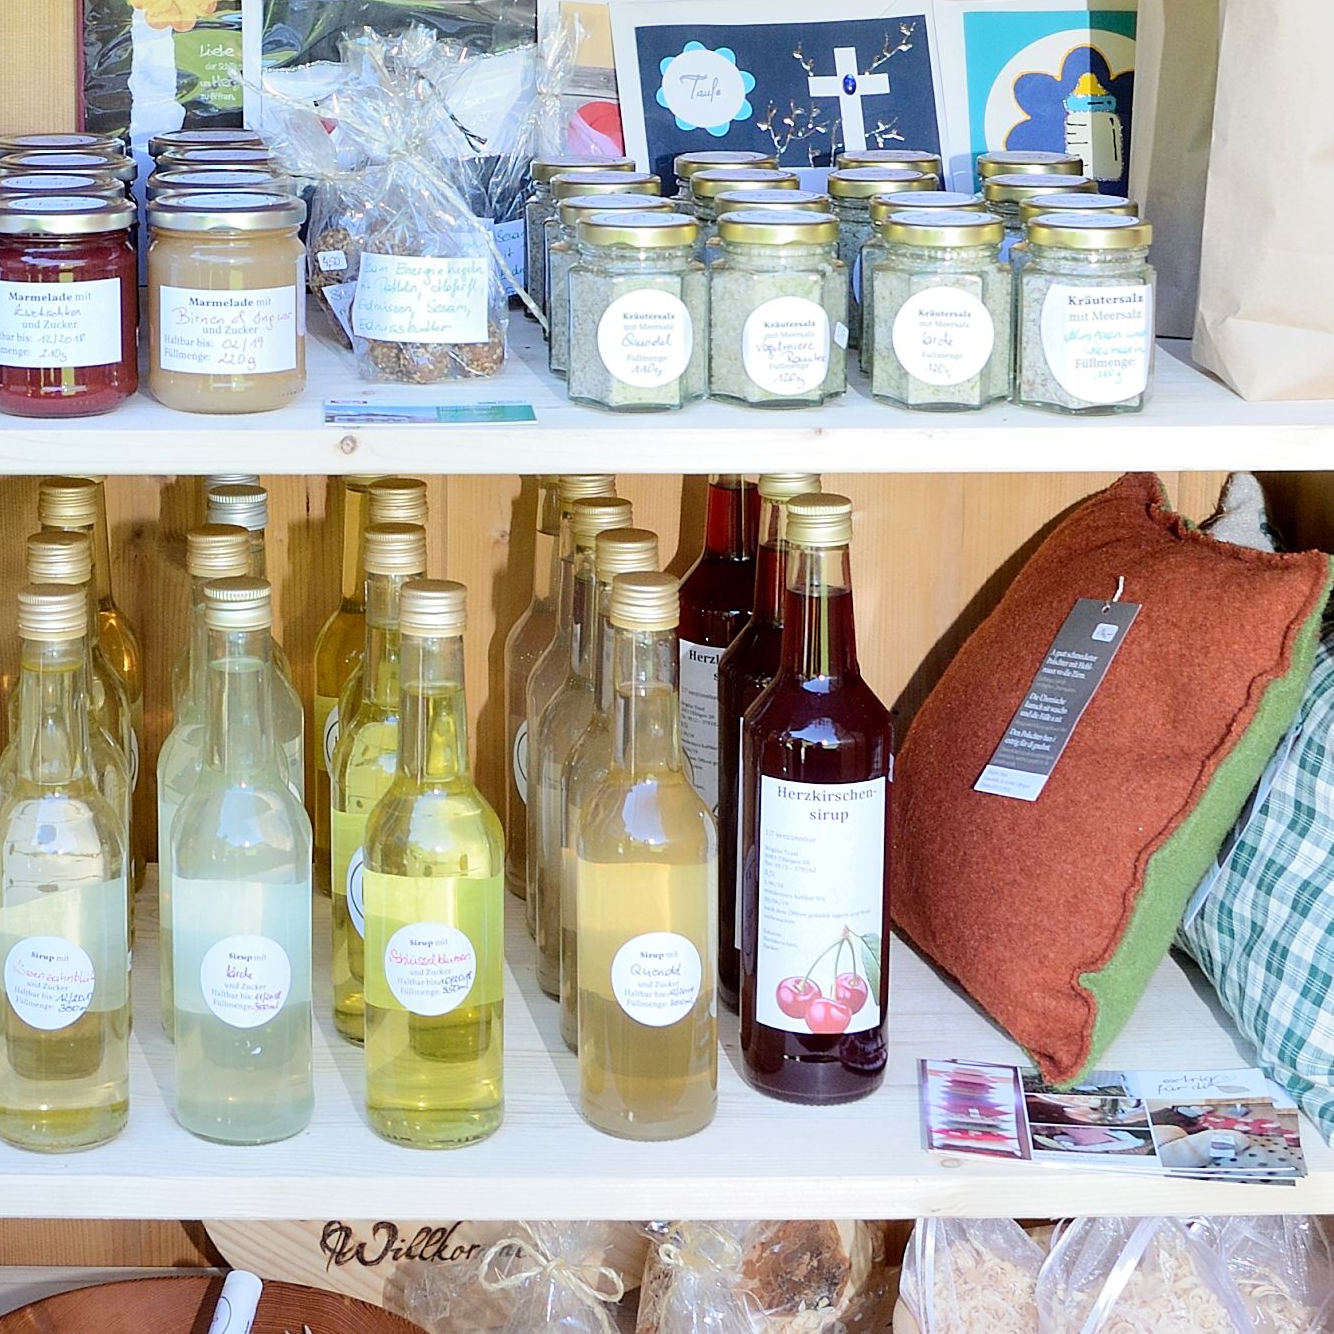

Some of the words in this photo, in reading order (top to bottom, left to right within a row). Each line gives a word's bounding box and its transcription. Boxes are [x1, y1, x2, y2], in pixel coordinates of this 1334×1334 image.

[9, 292, 72, 302] Marmelade
[76, 292, 91, 301] mit
[189, 297, 253, 307] Marmelade
[256, 297, 271, 306] mit
[1068, 293, 1143, 305] Kräutersalz
[623, 312, 675, 320] Kräutersalz
[918, 309, 971, 318] Kräutersalz
[1092, 309, 1142, 321] Meersalz
[22, 320, 40, 329] und
[43, 320, 77, 329] Zucker
[640, 323, 674, 331] Meersalz
[764, 320, 815, 328] Kräutersalz
[203, 325, 221, 334] und
[223, 325, 258, 334] Zucker
[165, 335, 195, 347] Haltbar
[165, 349, 210, 361] Füllmenge:
[777, 785, 877, 802] Herzkirschen-
[809, 808, 849, 823] sirup
[410, 938, 434, 948] Sirup
[31, 951, 54, 963] Sirup
[228, 952, 252, 963] Sirup
[640, 950, 664, 960] Sirup
